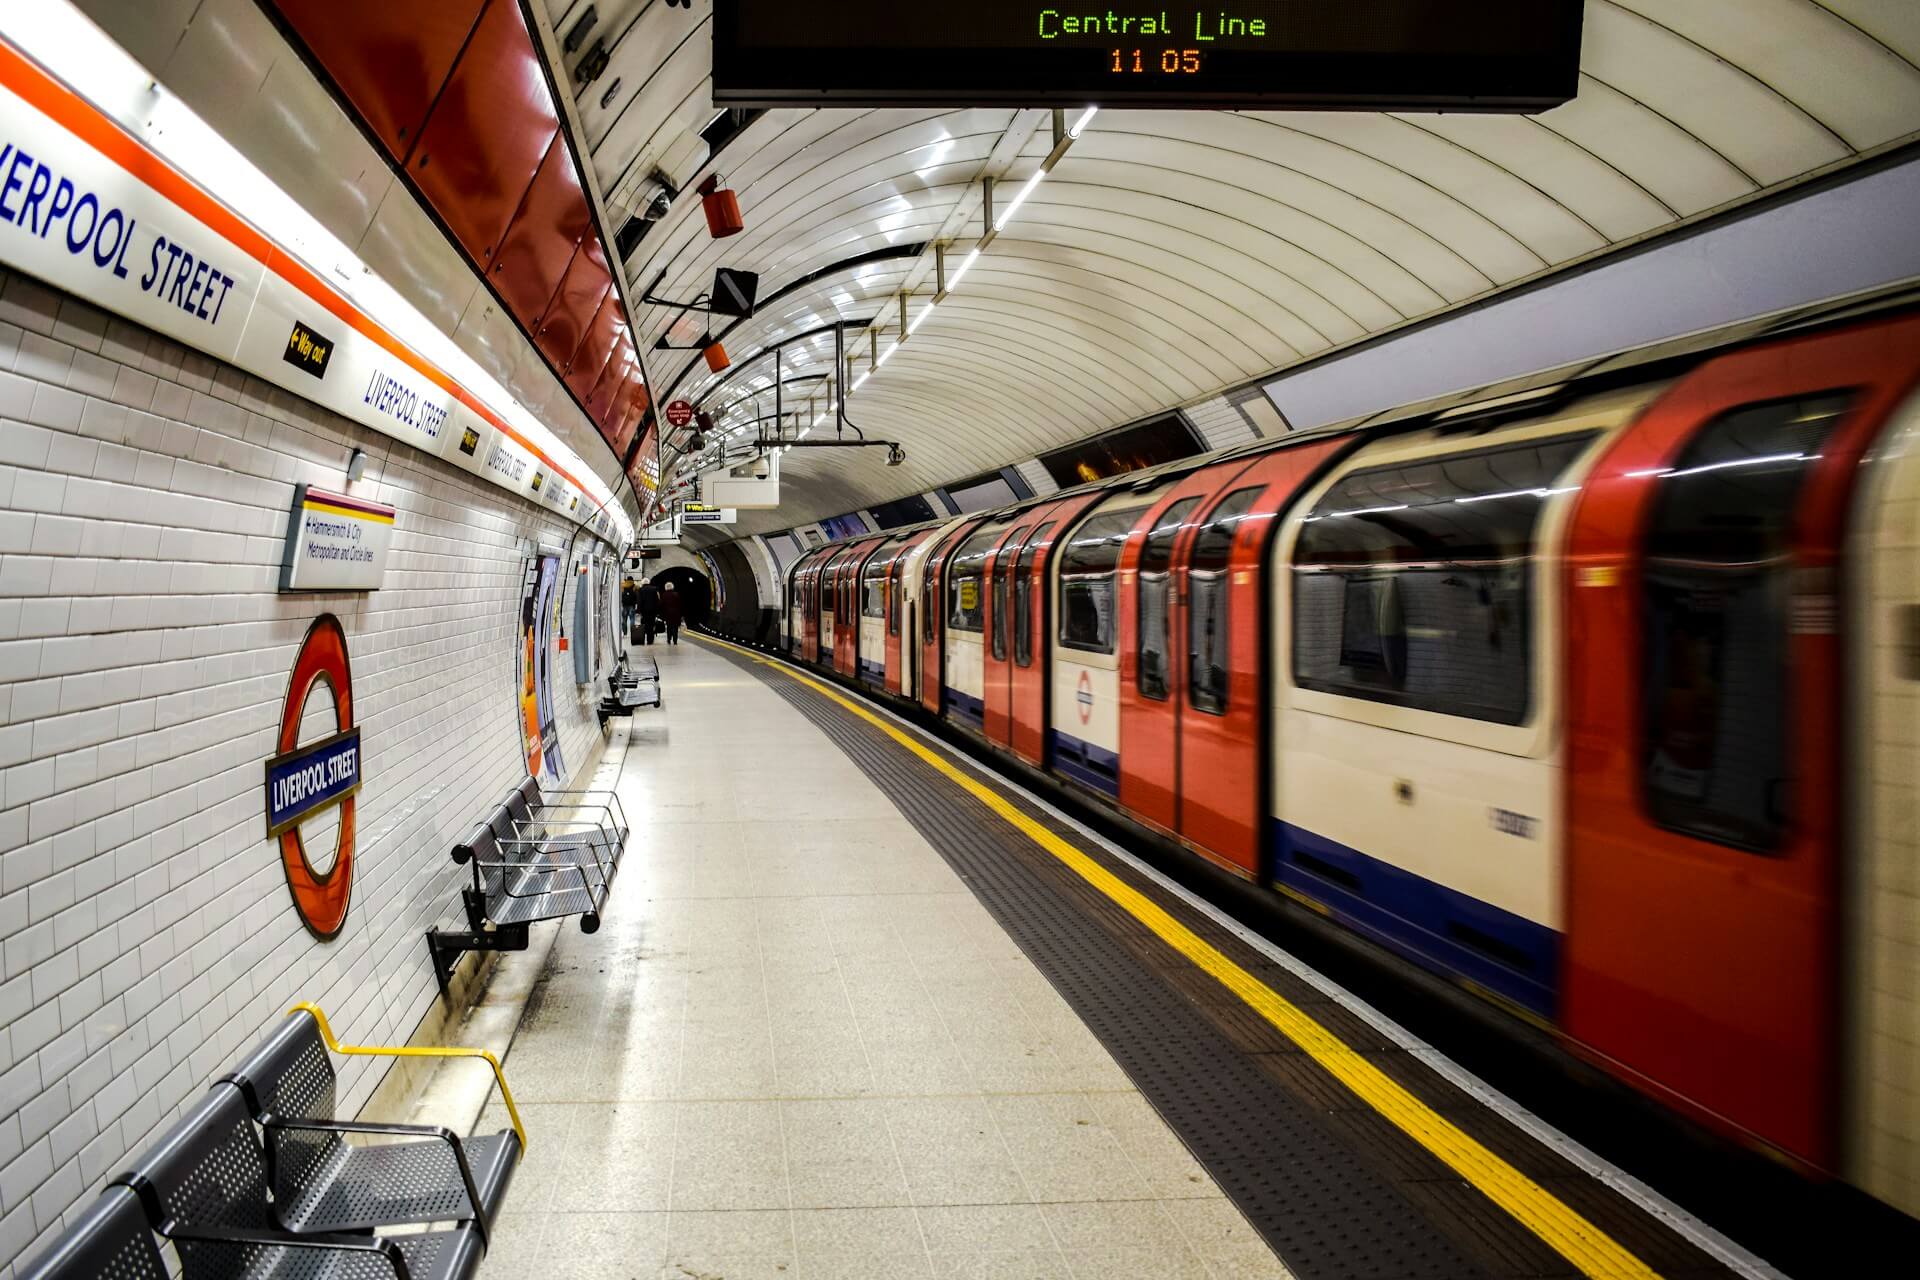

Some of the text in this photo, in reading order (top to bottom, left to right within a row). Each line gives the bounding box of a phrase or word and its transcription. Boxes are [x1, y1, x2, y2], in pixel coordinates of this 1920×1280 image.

[1039, 10, 1265, 41] Central Line
[1162, 49, 1199, 73] 05
[141, 236, 234, 325] STREET
[297, 330, 326, 364] Way out
[364, 369, 448, 439] LIVERPOOL STREET
[311, 517, 346, 538] Hammersmith
[352, 523, 362, 544] City
[306, 541, 374, 563] Metropolitan and Circle lines
[274, 748, 356, 813] LIVERPOOL STREET
